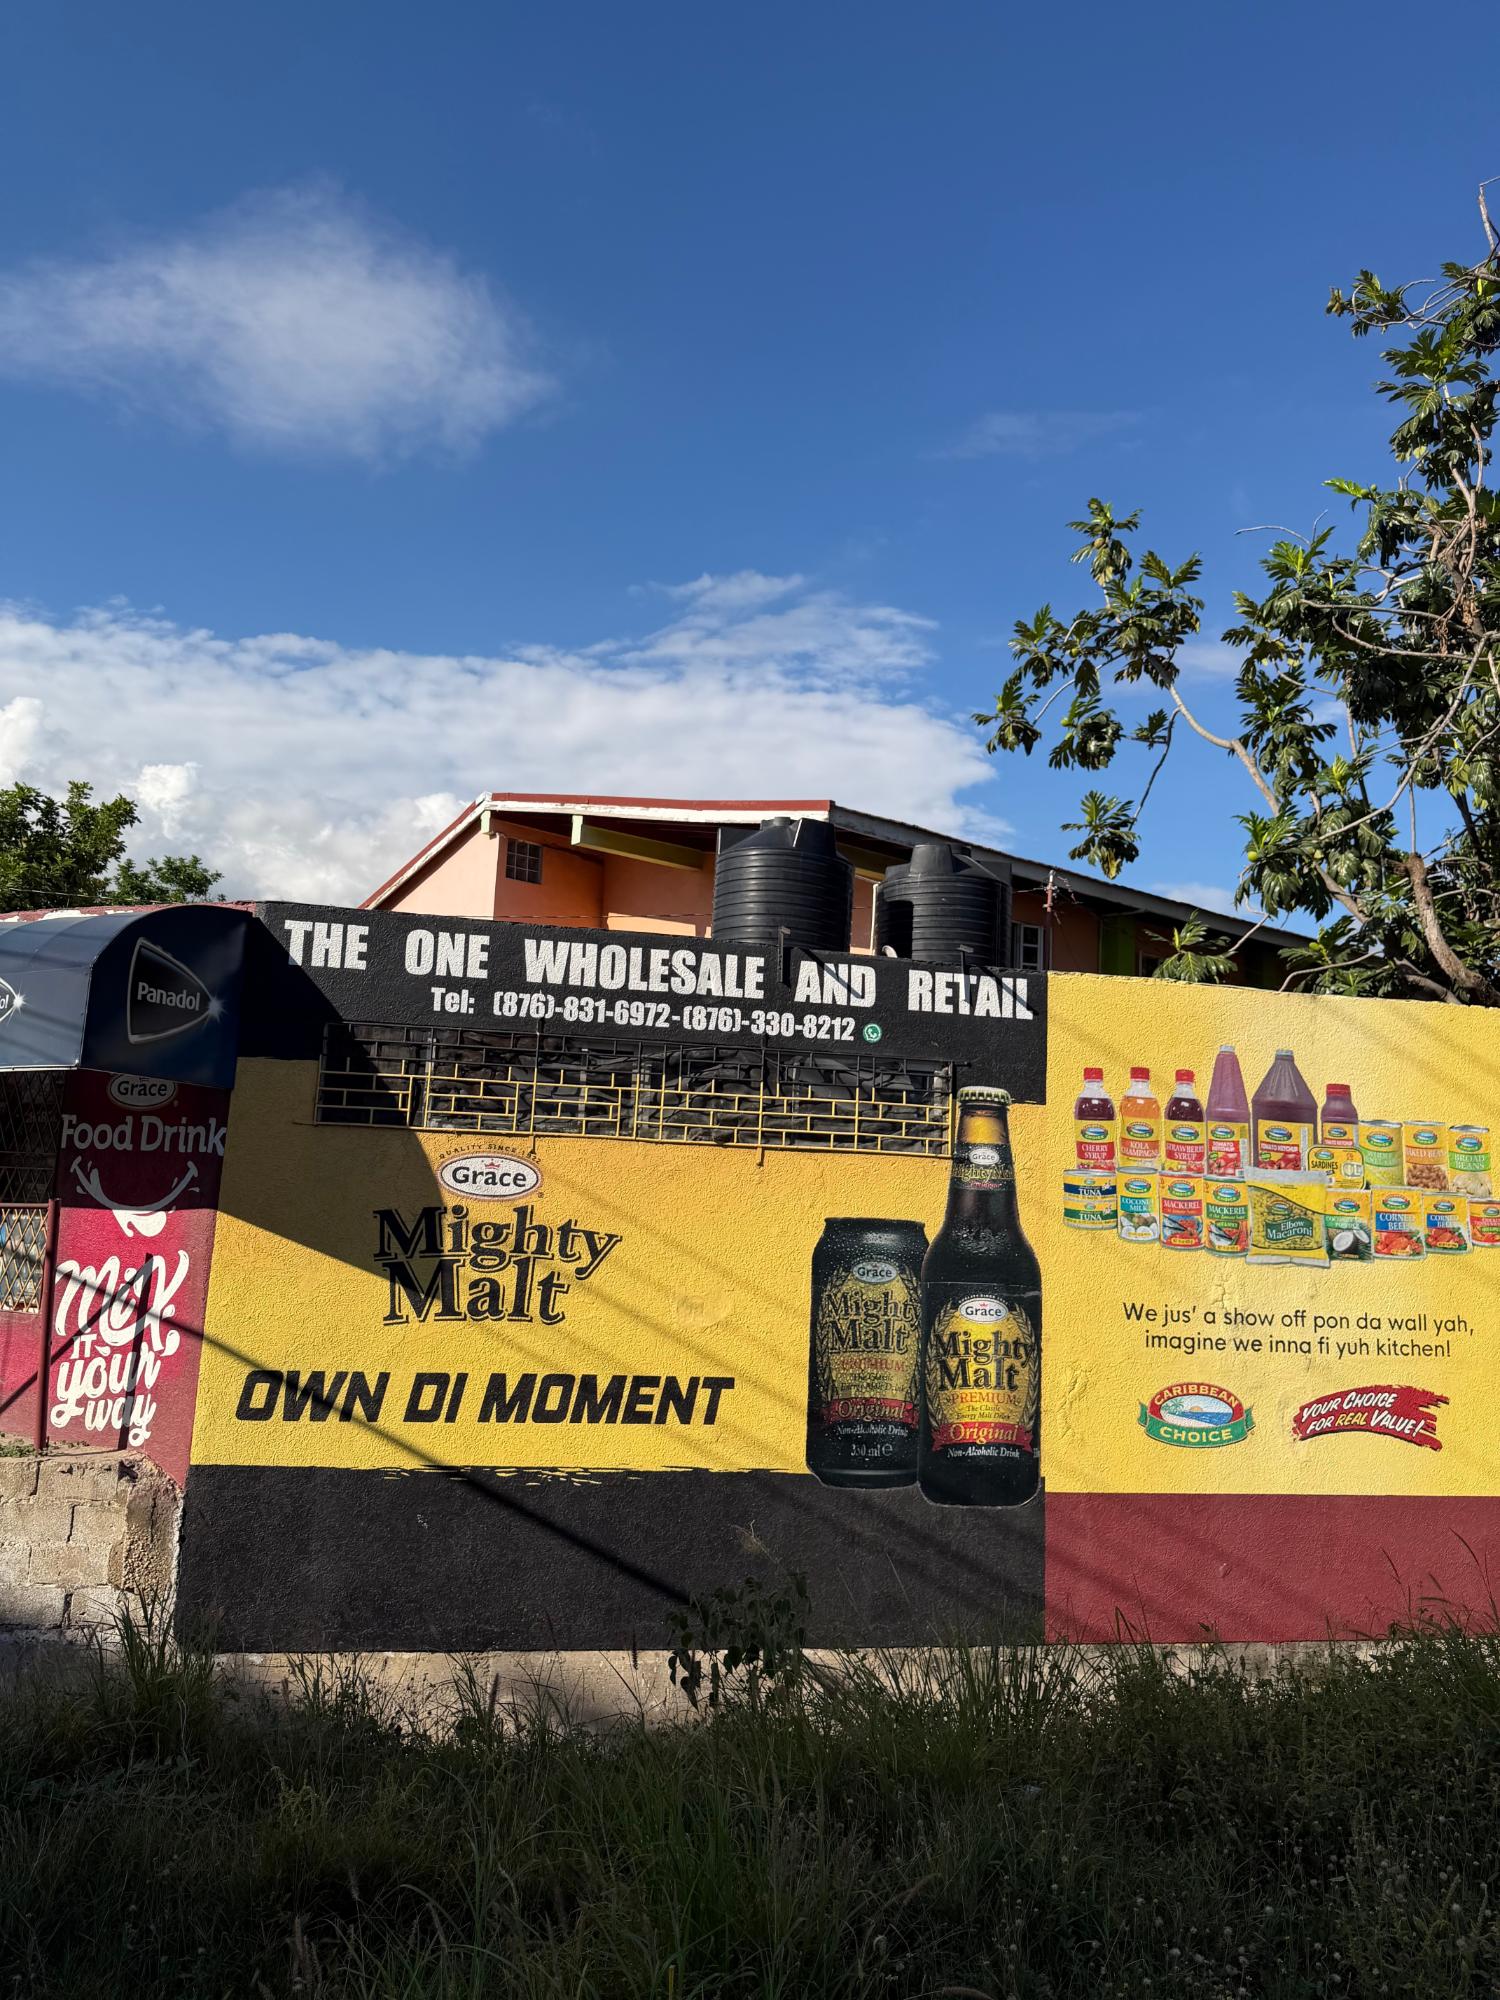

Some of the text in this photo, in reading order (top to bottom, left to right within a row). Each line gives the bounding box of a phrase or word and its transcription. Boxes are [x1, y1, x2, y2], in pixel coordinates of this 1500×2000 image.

[284, 919, 1034, 1020] THE ONE WHOLESALE AND RETAIL
[137, 981, 201, 1011] Panadol
[431, 987, 475, 1014] Tel:
[116, 1081, 168, 1097] Grace
[60, 1114, 228, 1157] Food Drink
[1130, 1141, 1149, 1150] KOLA
[438, 1143, 482, 1159] QUALITY
[487, 1143, 517, 1154] SINCE
[972, 1153, 996, 1161] Grace
[1081, 1144, 1108, 1152] CHERRY
[1084, 1151, 1107, 1160] SYRUP
[1310, 1160, 1339, 1170] SARDINES
[452, 1166, 527, 1188] Grace
[1079, 1188, 1102, 1196] TUNA
[1164, 1199, 1200, 1209] MACKEREL
[1209, 1204, 1245, 1215] MACKEREL
[1079, 1213, 1102, 1221] TUNA
[1280, 1220, 1305, 1231] Elbow
[373, 1204, 623, 1281] Mighty
[1266, 1227, 1312, 1240] Macaroni
[857, 1267, 892, 1277] Grace
[382, 1258, 570, 1326] Malt
[825, 1290, 919, 1330] Mighty
[965, 1306, 1002, 1317] Grace
[1123, 1302, 1475, 1337] We jus' a show off pon da wall yah,
[827, 1318, 909, 1355] Malt
[1145, 1329, 1451, 1359] imagine we inna fi yuh kitchen!
[934, 1330, 1033, 1368] Mighty
[936, 1357, 1020, 1391] Malt
[235, 1369, 735, 1425] OWN DI MOMENT
[951, 1391, 1017, 1405] PREMIUM
[1153, 1383, 1240, 1407] CARIBBEAN
[839, 1400, 905, 1422] Original
[1301, 1391, 1398, 1422] YOUR CHOICE
[84, 1394, 158, 1447] way
[1306, 1411, 1426, 1438] FOR REAL VALUE!
[950, 1422, 1019, 1445] Original
[1158, 1426, 1233, 1443] CHOICE
[947, 1446, 998, 1458] Non-Alcoholic
[1000, 1447, 1020, 1459] Drink
